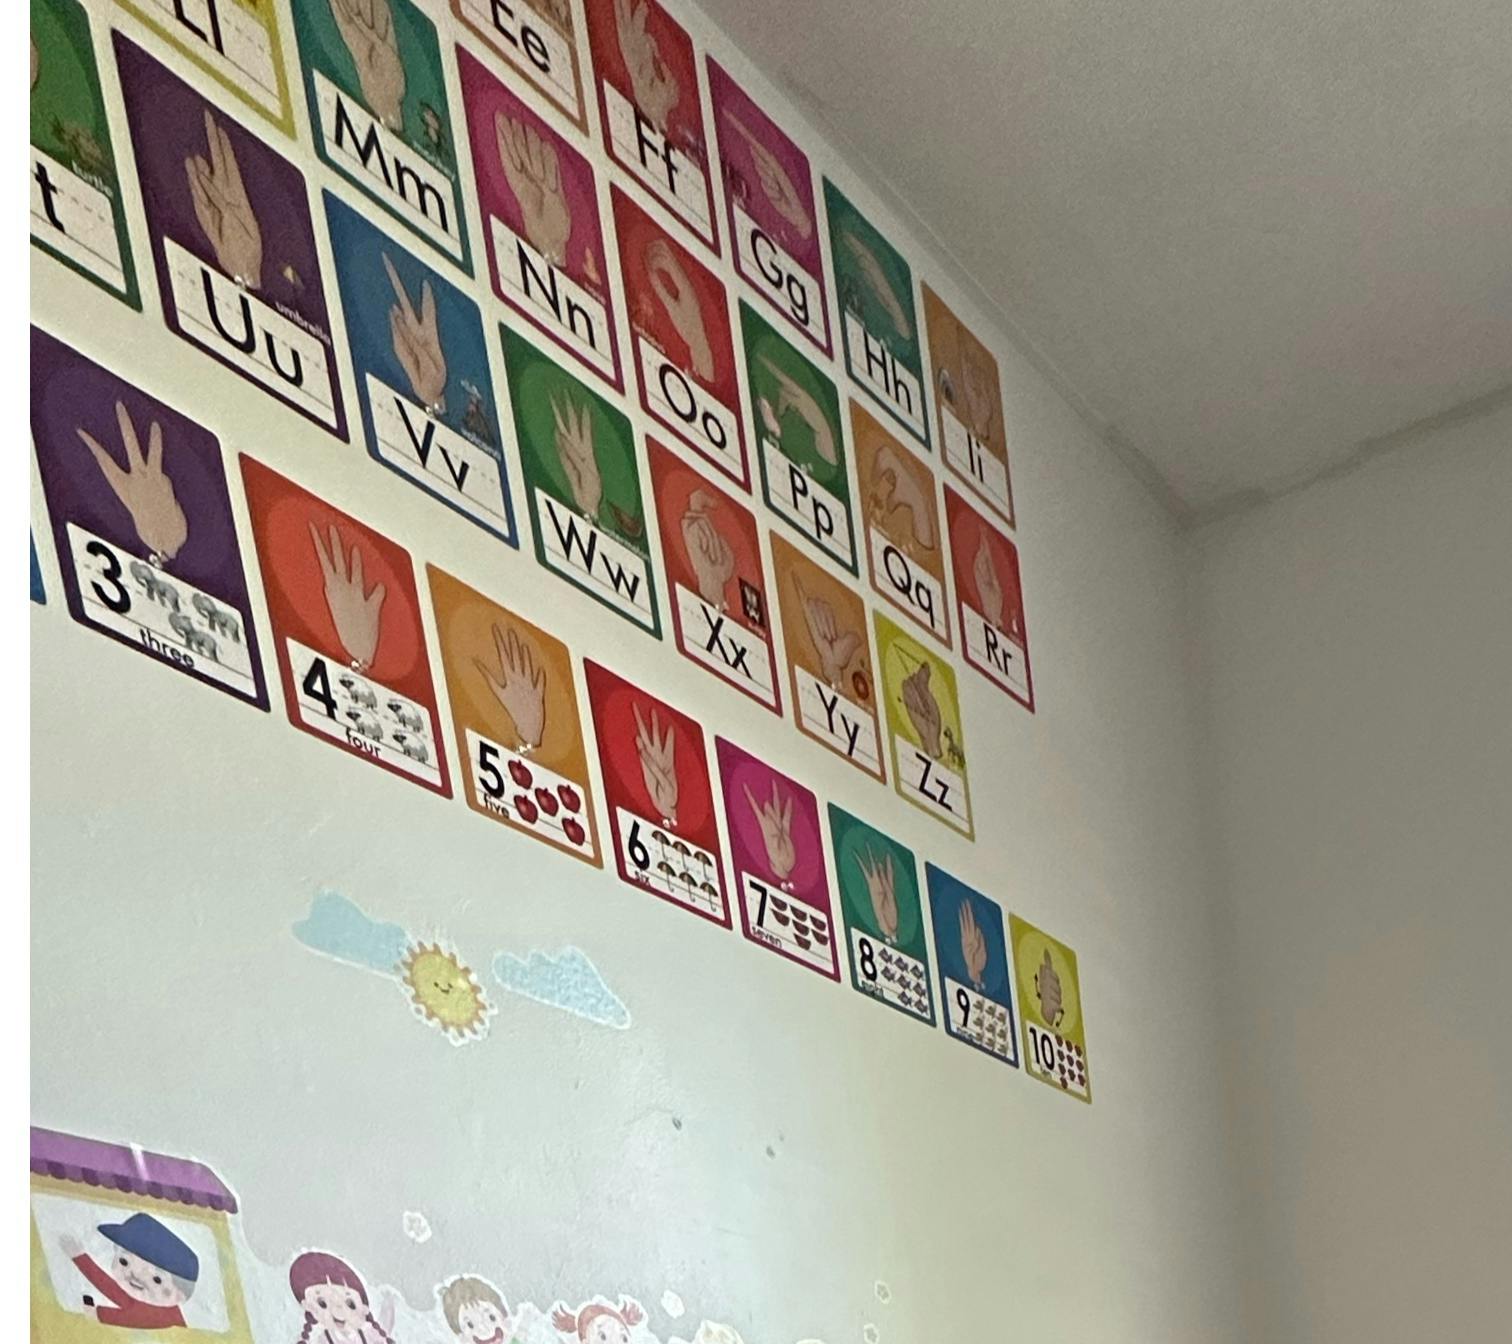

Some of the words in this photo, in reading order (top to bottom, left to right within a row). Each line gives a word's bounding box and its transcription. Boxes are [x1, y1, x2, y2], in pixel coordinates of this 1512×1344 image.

[490, 0, 550, 73] Ee
[335, 93, 448, 233] Mm
[634, 107, 679, 195] Ff
[516, 238, 596, 349] Nn
[751, 228, 809, 326] Gg
[201, 267, 303, 387] Uu
[659, 363, 727, 450] Oo
[863, 327, 912, 415] Hh
[394, 396, 470, 492] Vv
[789, 463, 833, 540] Pp
[86, 540, 131, 614] 3
[545, 499, 640, 603] Ww
[883, 545, 936, 628] Qq
[140, 628, 195, 669] three
[701, 604, 752, 679] Xx
[983, 623, 1012, 677] Rr
[302, 657, 338, 722] 4
[815, 682, 860, 756] Yy
[345, 725, 383, 758] four
[479, 742, 505, 799] 5
[483, 793, 511, 819] five
[915, 752, 953, 812] Zz
[628, 820, 650, 872] 6
[634, 870, 650, 886] six
[750, 880, 767, 928] 7
[752, 926, 783, 949] seven
[858, 937, 877, 982] 8
[957, 988, 970, 1028] 9
[1029, 1027, 1056, 1071] 10
